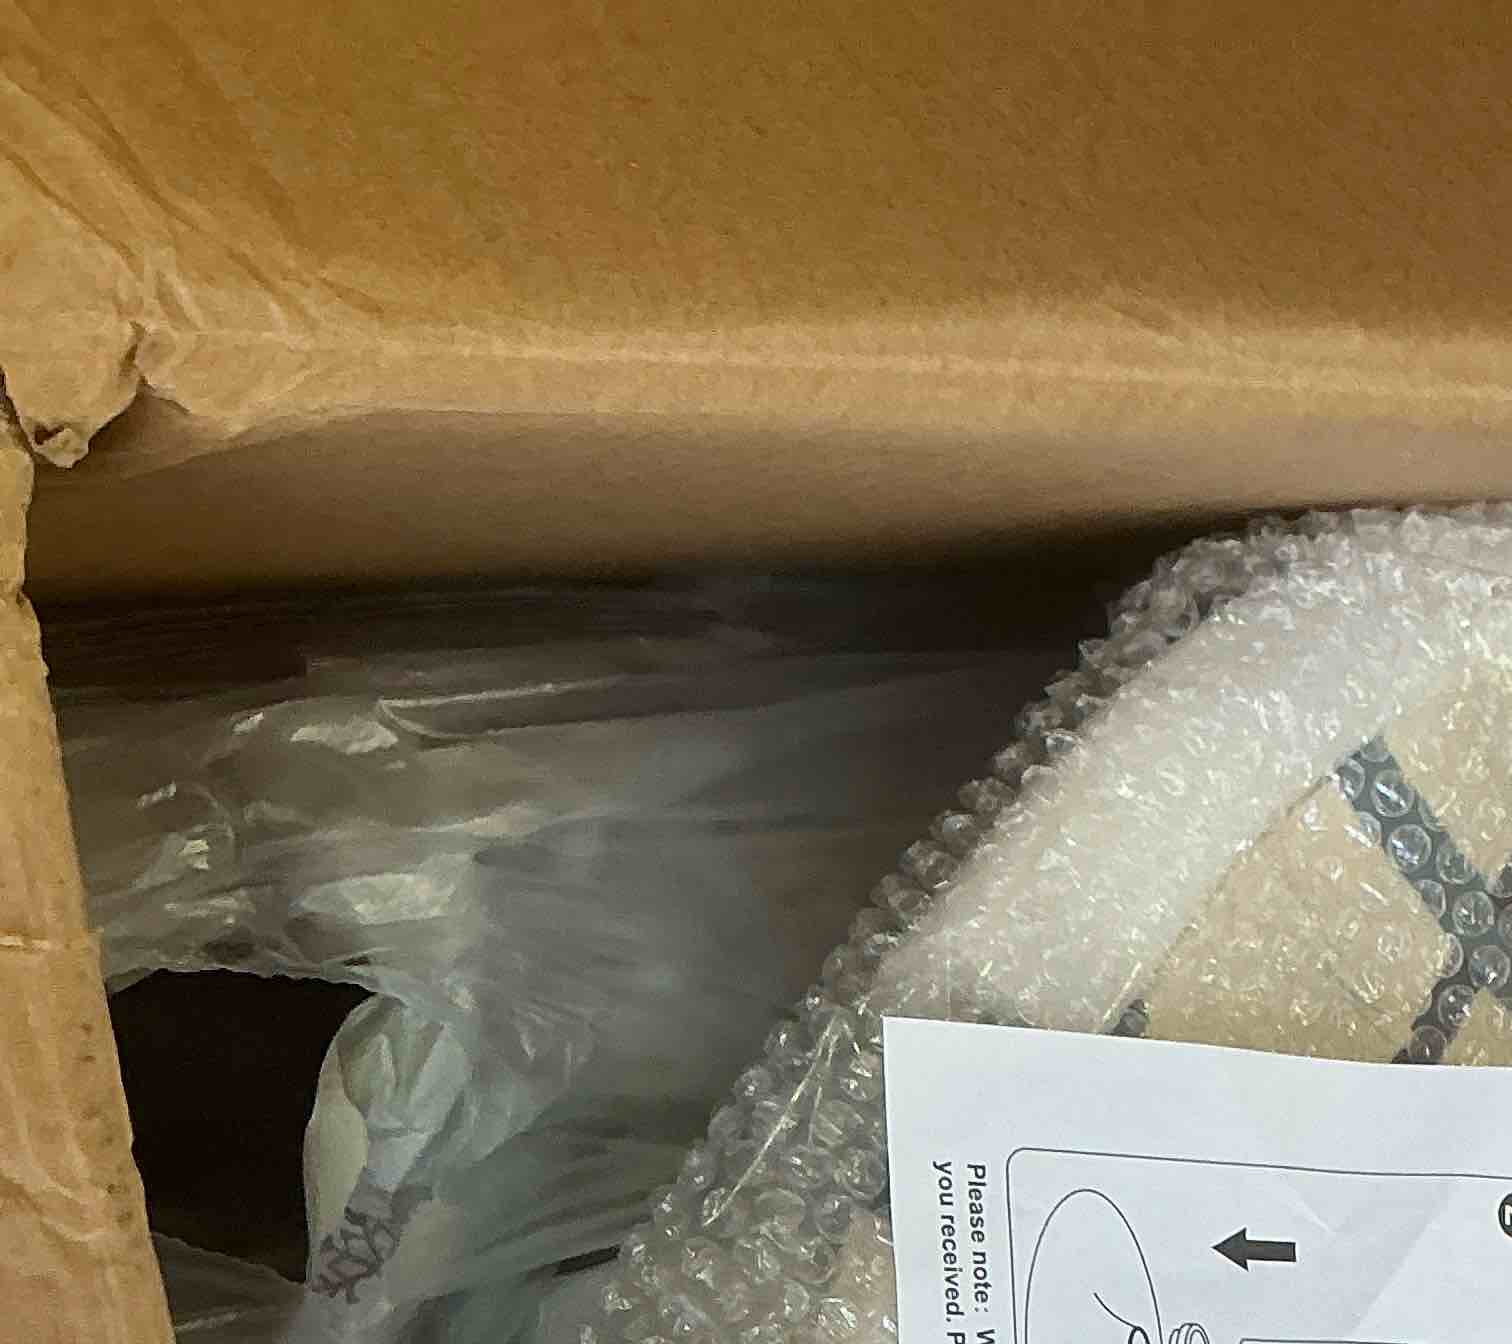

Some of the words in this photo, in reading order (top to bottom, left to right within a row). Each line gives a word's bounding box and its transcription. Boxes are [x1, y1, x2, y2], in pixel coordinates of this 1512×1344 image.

[932, 1161, 953, 1206] you
[966, 1164, 987, 1242] Please
[940, 1215, 963, 1323] received.
[971, 1251, 990, 1313] note:
